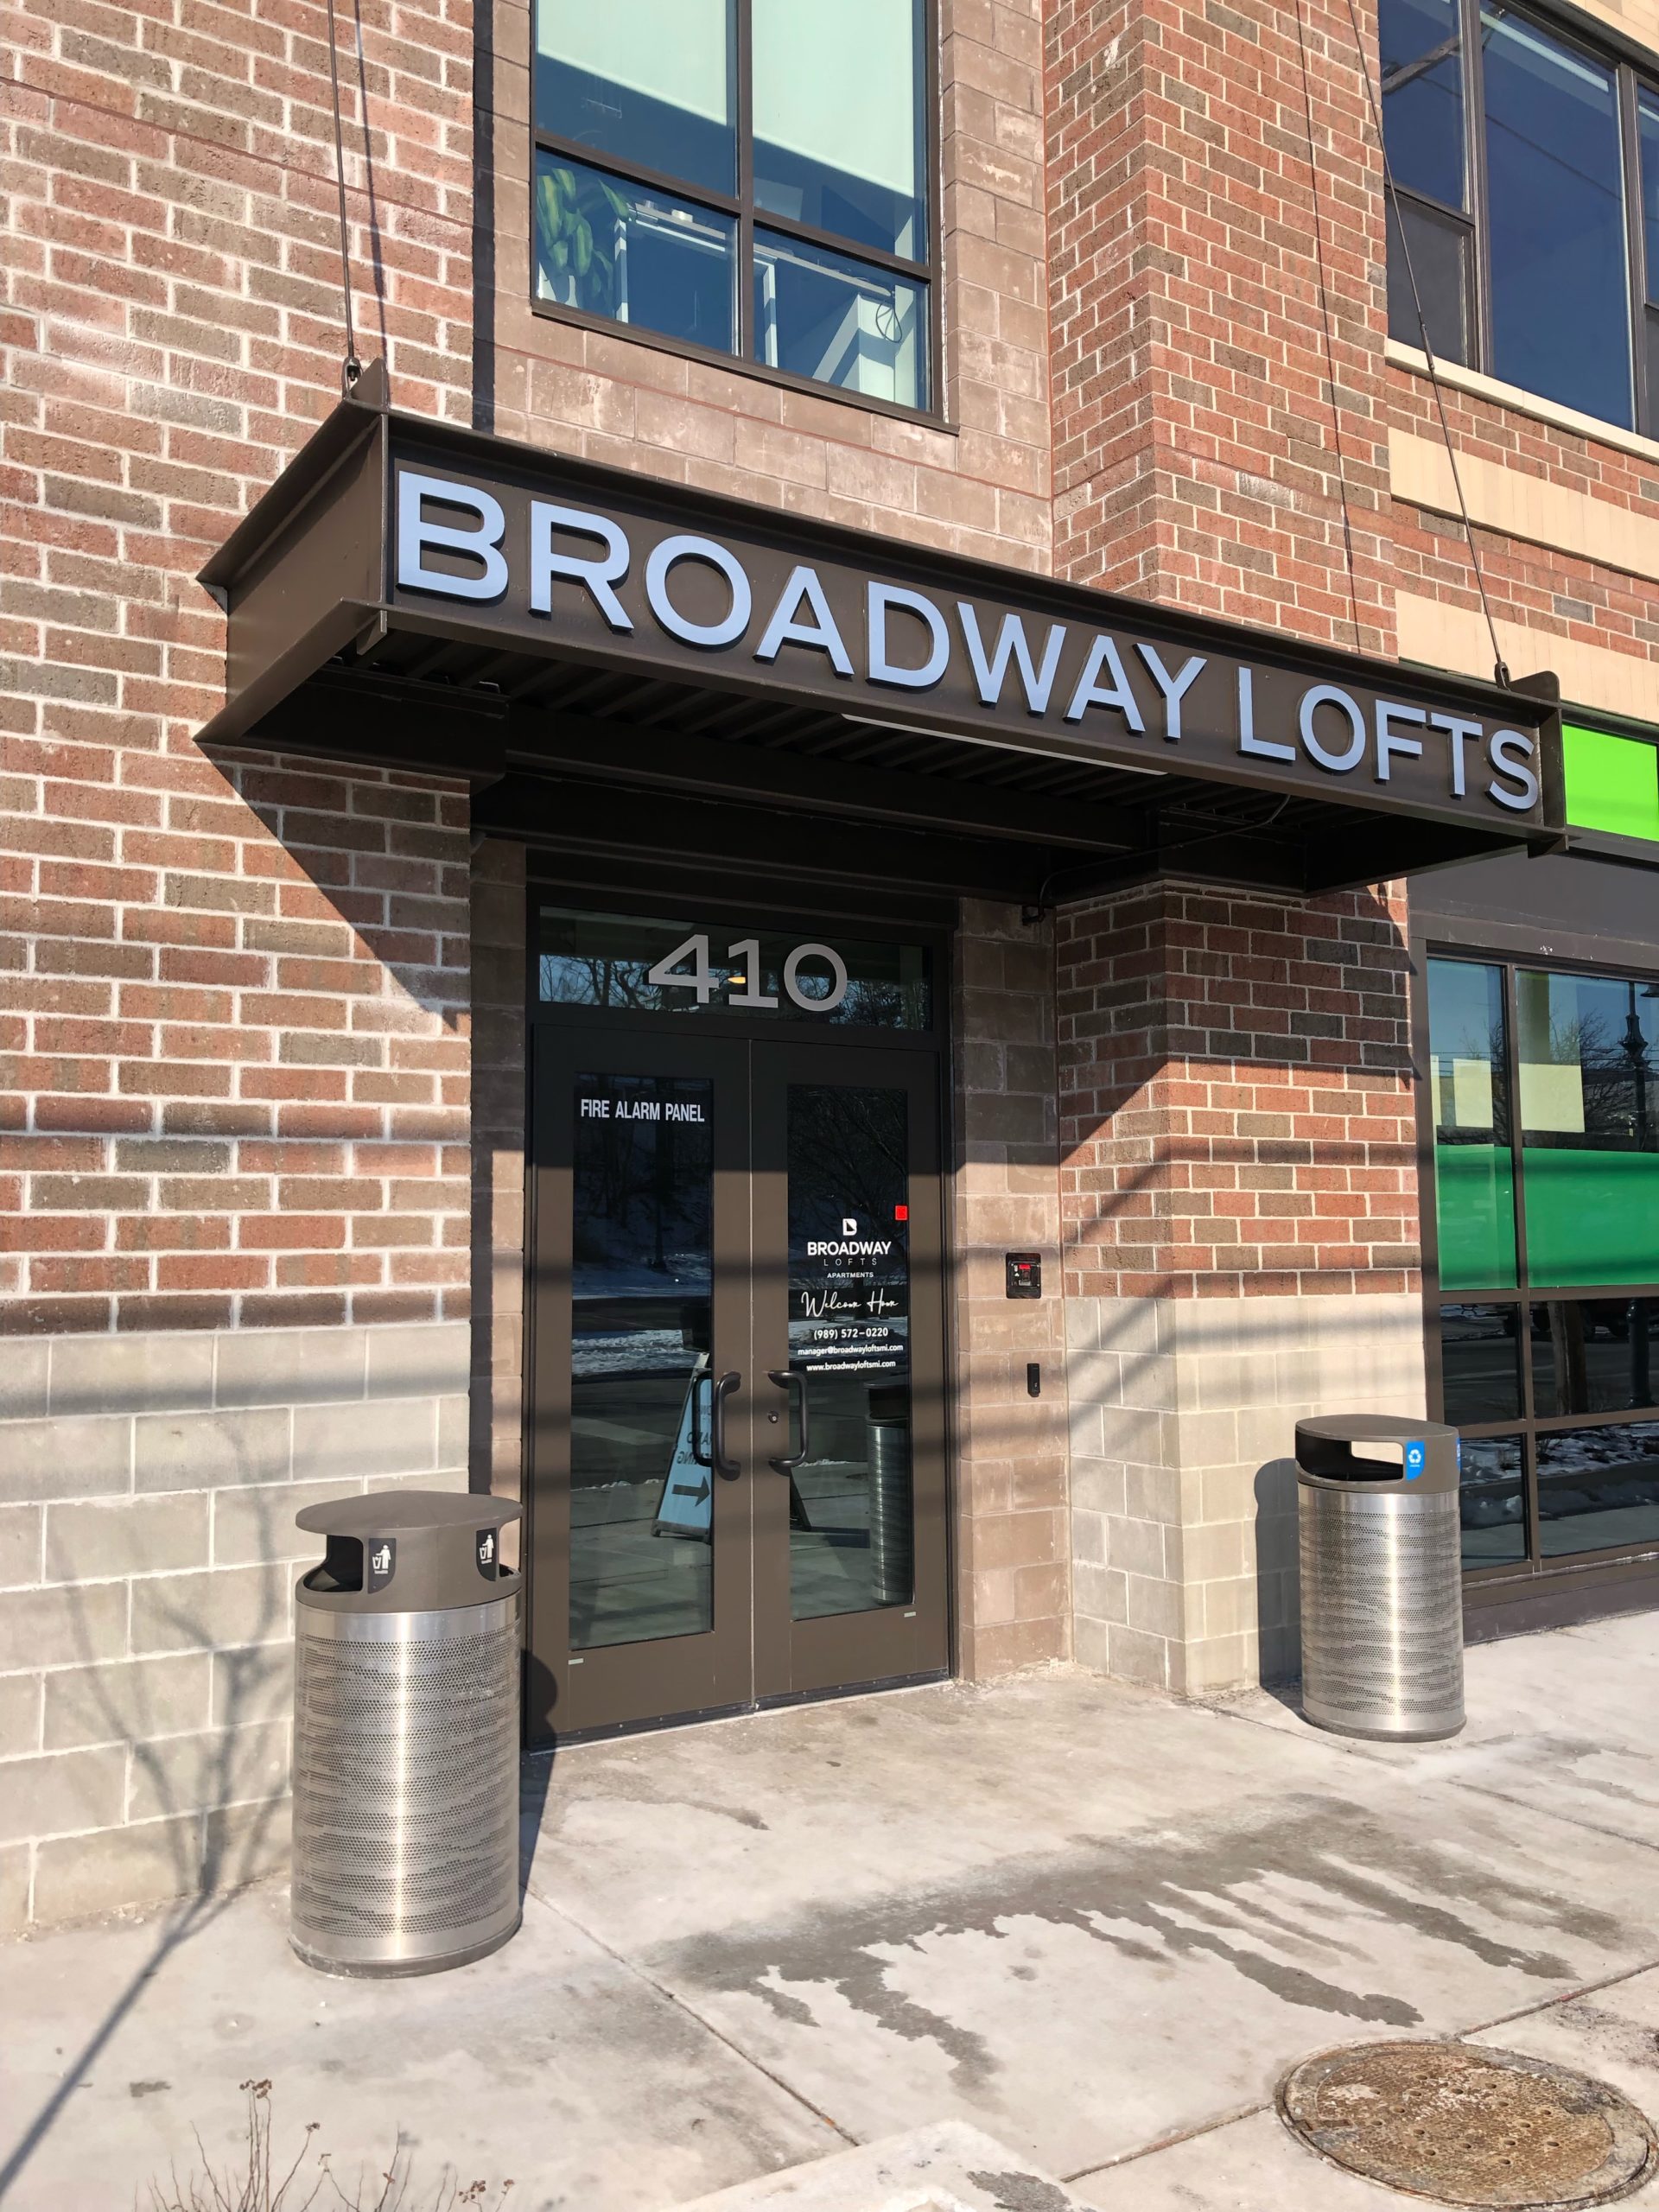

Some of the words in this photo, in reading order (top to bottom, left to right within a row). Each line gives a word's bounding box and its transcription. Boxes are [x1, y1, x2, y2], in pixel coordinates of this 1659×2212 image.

[394, 470, 1207, 741] BROADWAY
[1236, 666, 1540, 814] LOFTS
[648, 934, 848, 1012] 410
[581, 1098, 610, 1118] FIRE
[614, 1100, 660, 1121] ALARM
[665, 1103, 705, 1122] PANEL
[807, 1241, 892, 1255] BROADWAY
[823, 1257, 877, 1266] LOFTS
[801, 1289, 861, 1317] Welcome
[867, 1287, 899, 1314] Home
[814, 1329, 838, 1340] (989)
[841, 1327, 888, 1338] 572-0220
[798, 1344, 904, 1357] manager@broadwayloftsmi.com
[806, 1360, 896, 1371] www.broadwayloftsmi.com
